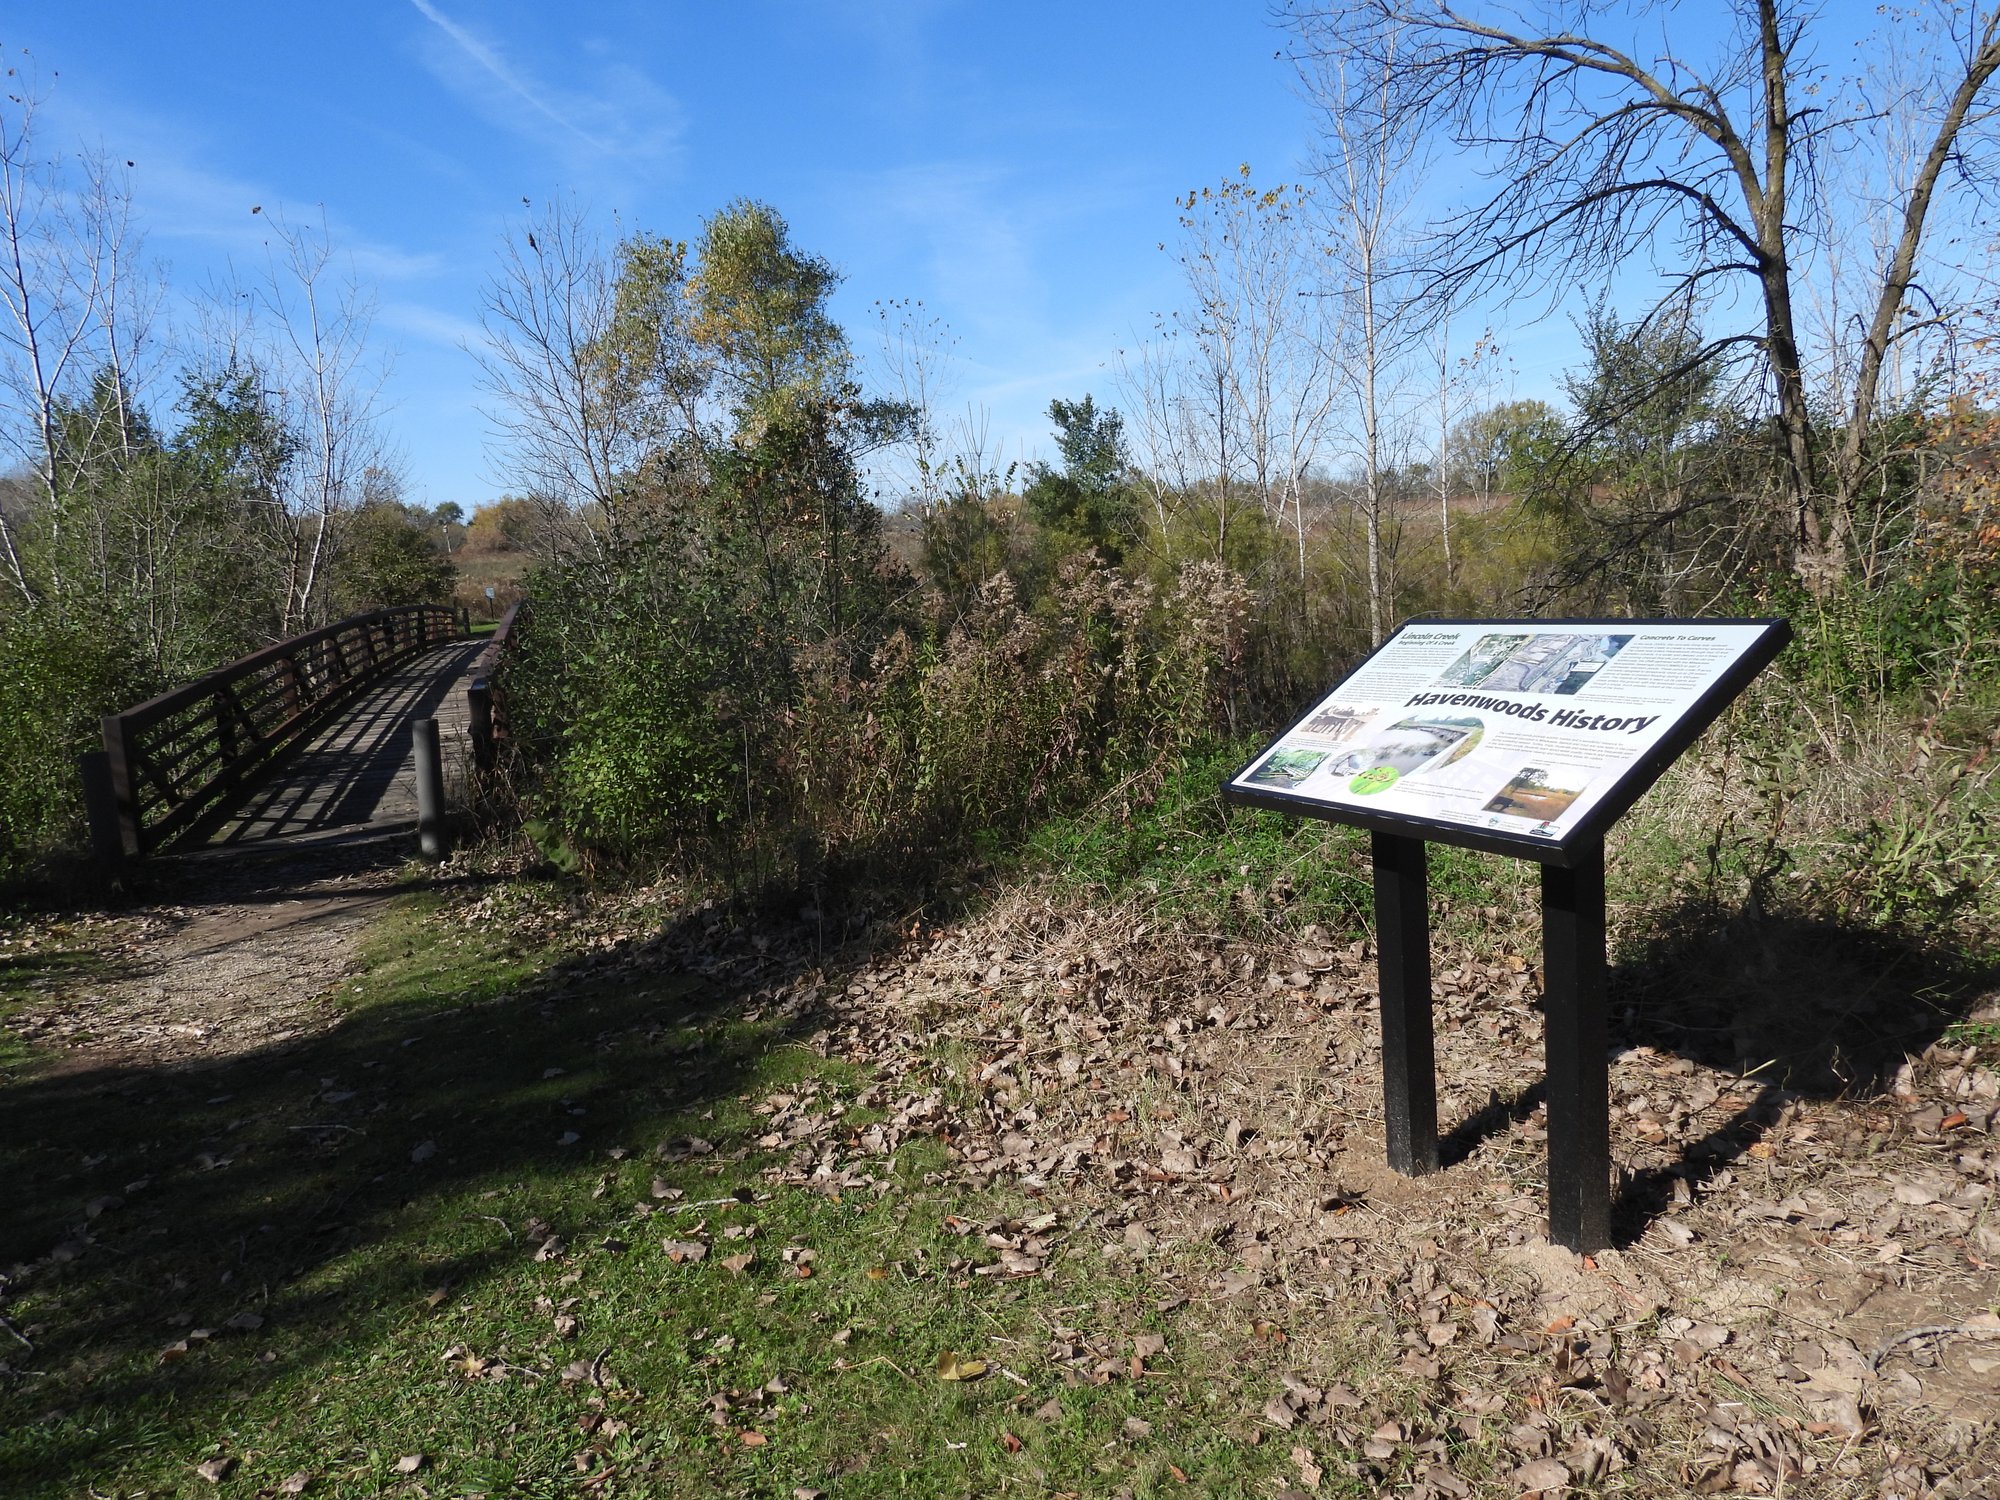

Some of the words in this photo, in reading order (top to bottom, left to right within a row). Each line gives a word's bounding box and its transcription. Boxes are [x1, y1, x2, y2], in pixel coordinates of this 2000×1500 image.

[1400, 632, 1433, 640] Lincoln
[1433, 632, 1461, 640] Creek
[1403, 692, 1550, 722] Havenwoods
[1547, 708, 1662, 735] History
